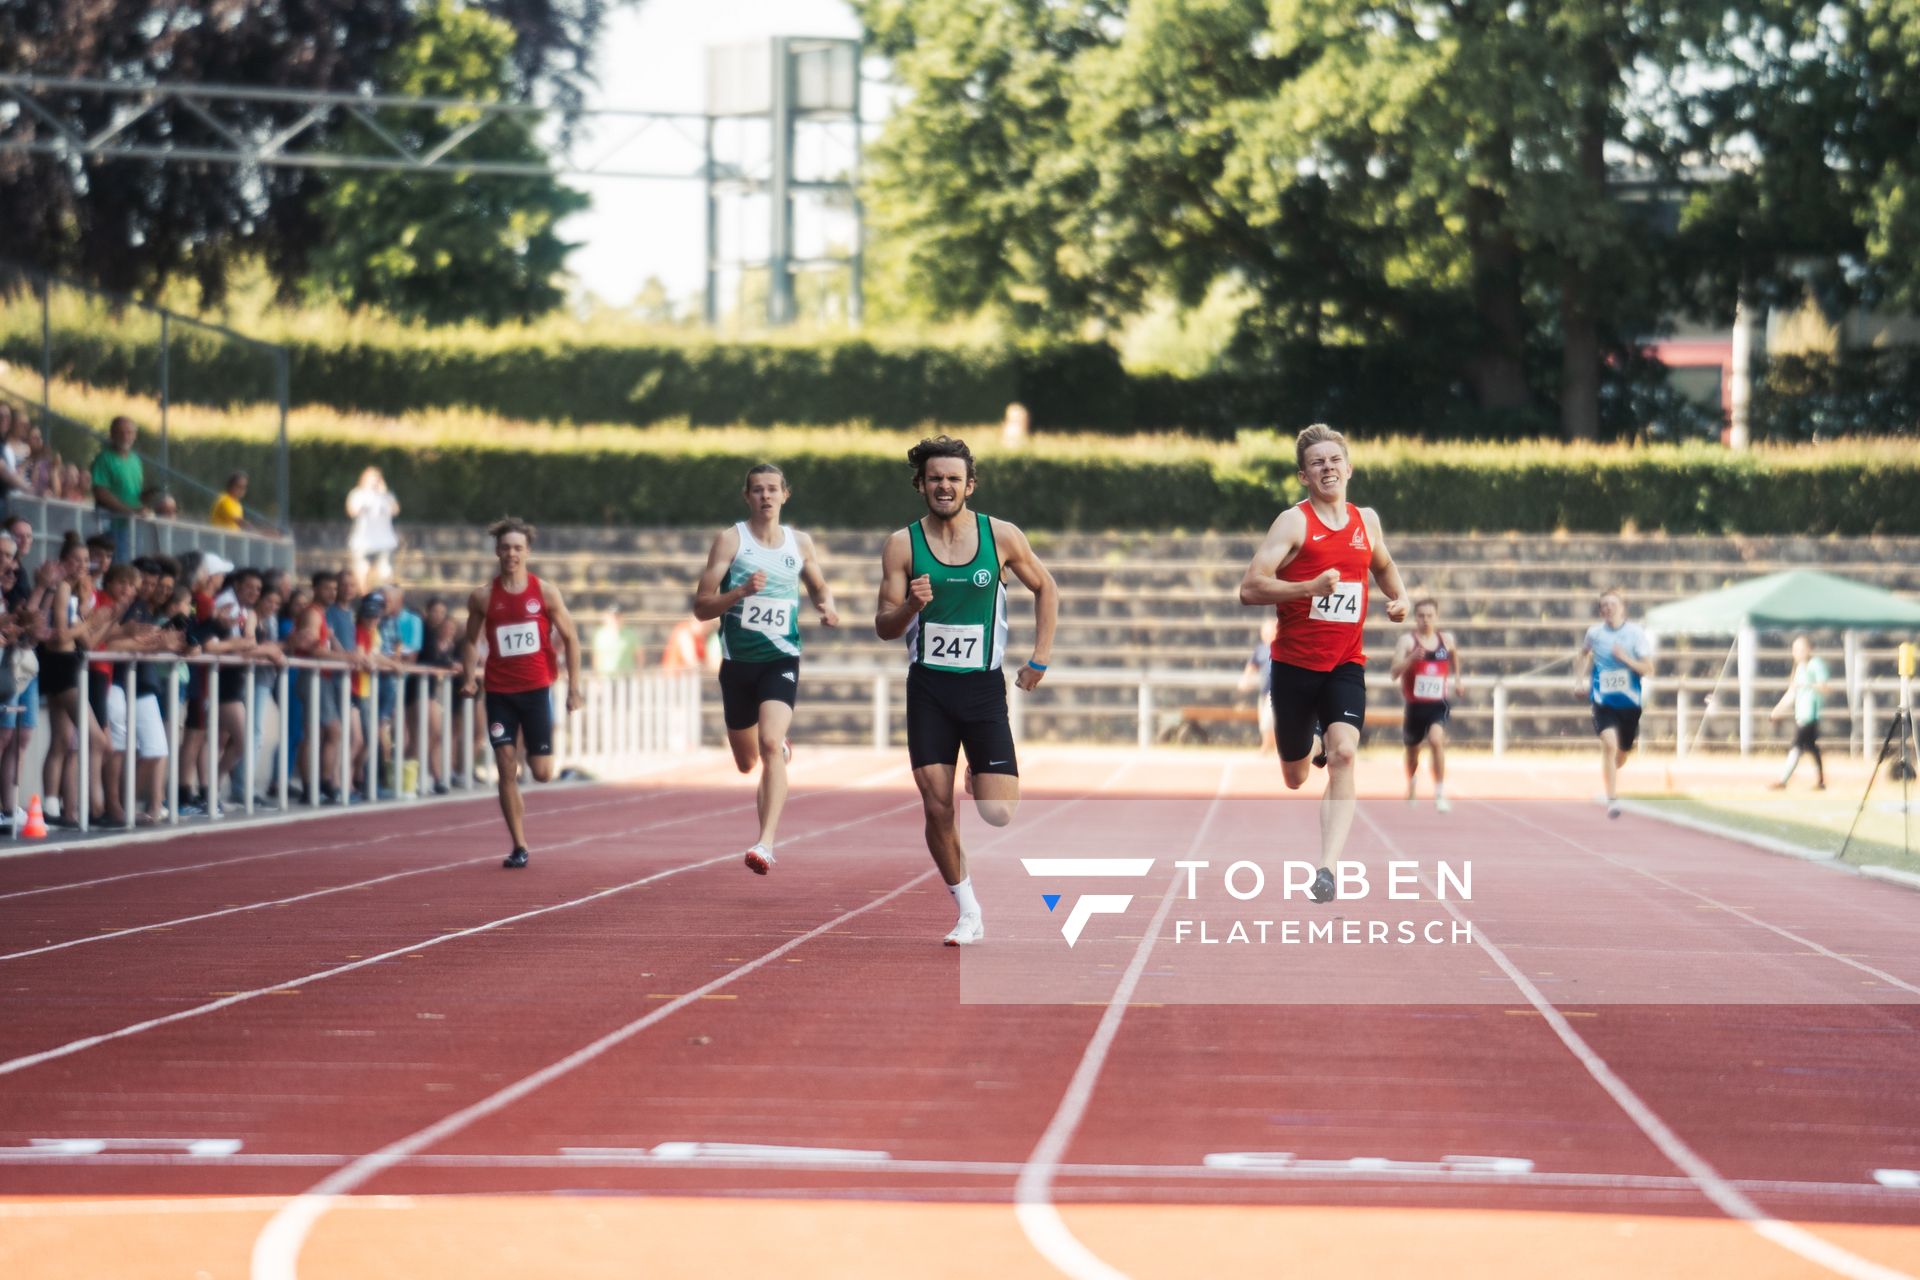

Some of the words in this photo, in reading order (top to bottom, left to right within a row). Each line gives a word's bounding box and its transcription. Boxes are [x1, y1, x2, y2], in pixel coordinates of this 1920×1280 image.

[1317, 594, 1357, 614] 474
[748, 605, 786, 627] 245
[504, 632, 535, 650] 178
[931, 636, 977, 659] 247
